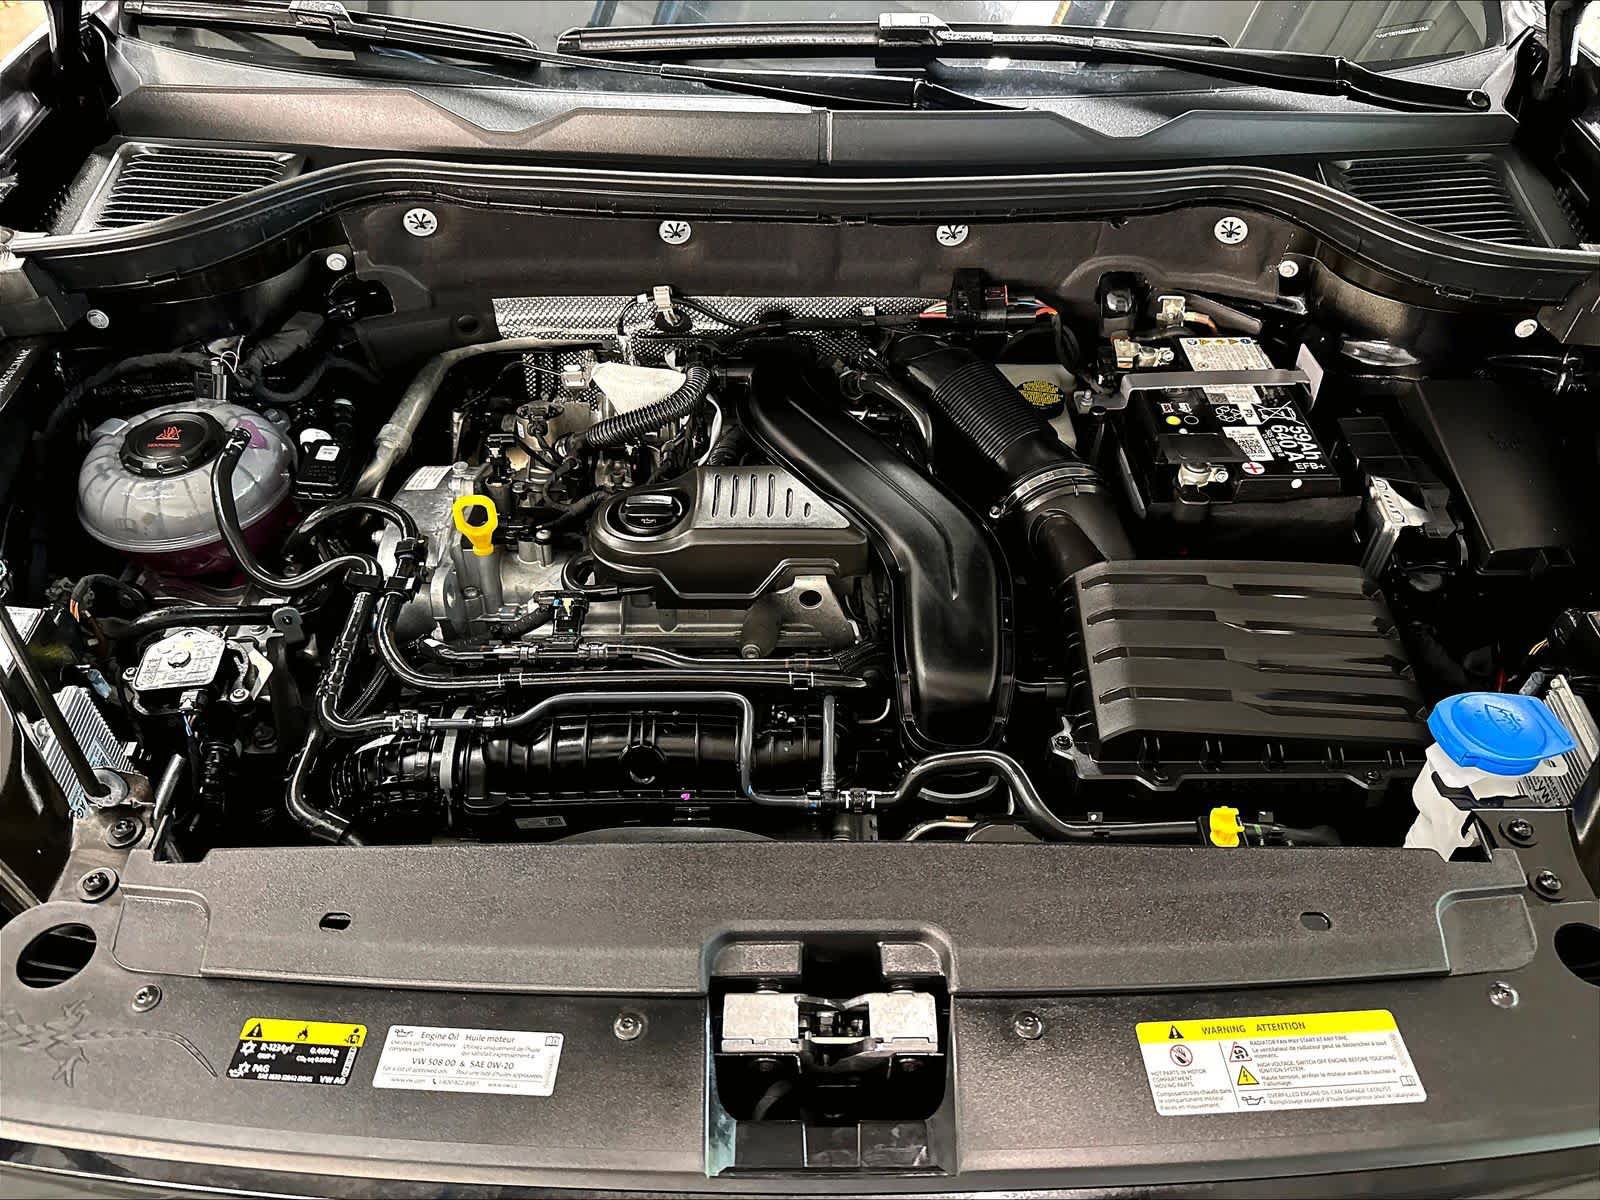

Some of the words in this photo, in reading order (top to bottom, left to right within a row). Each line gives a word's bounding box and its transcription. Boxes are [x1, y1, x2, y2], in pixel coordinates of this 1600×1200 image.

[1271, 424, 1297, 448] 640
[1286, 452, 1304, 462] A
[1288, 426, 1322, 460] 59Ah
[1202, 1025, 1246, 1034] WARNING
[1256, 1022, 1306, 1032] ATTENTION
[421, 1032, 447, 1041] Engine
[487, 1061, 514, 1070] 0W-20
[320, 1076, 333, 1084] VW
